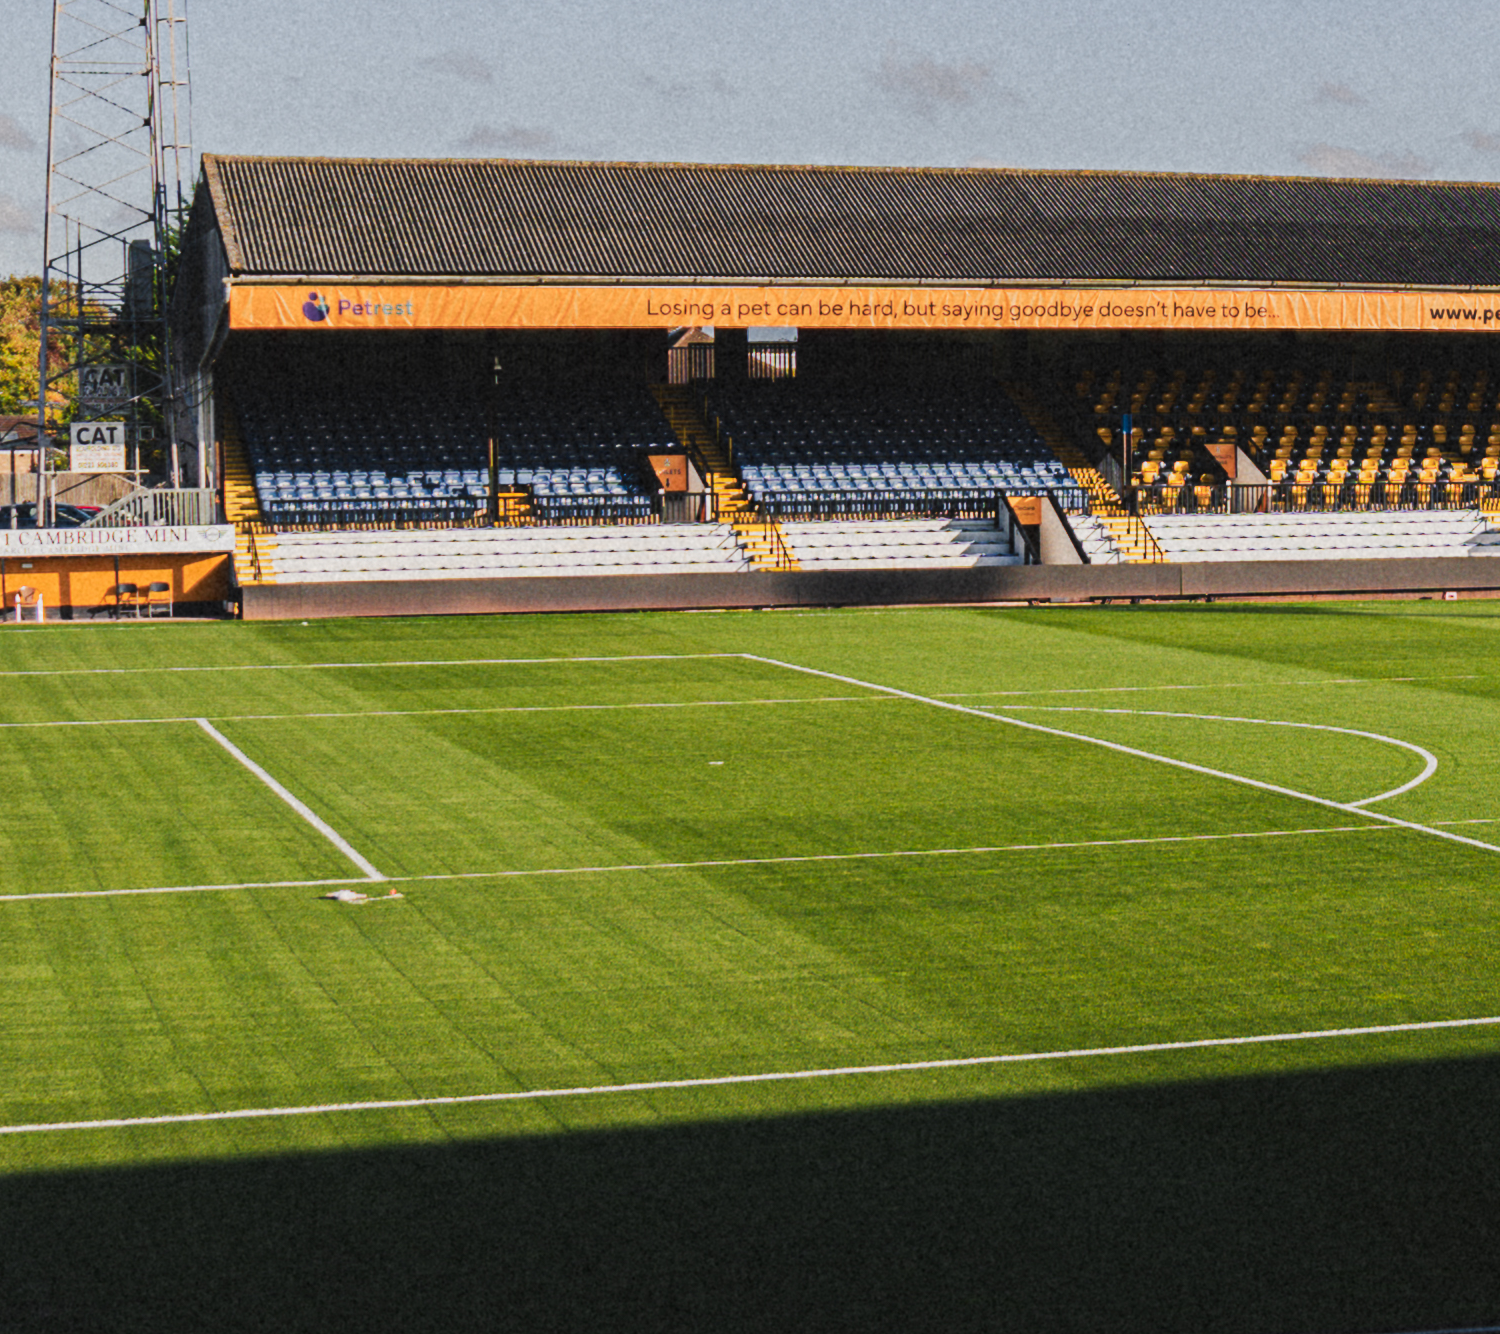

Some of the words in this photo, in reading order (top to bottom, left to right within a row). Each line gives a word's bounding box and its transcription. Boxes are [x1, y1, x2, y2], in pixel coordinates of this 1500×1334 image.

[338, 299, 414, 316] Petrest
[647, 299, 714, 319] Losing
[720, 303, 731, 316] a
[738, 300, 771, 319] pet
[777, 303, 812, 316] can
[818, 300, 843, 316] be
[850, 300, 898, 319] hard,
[904, 300, 936, 316] but
[942, 301, 1003, 320] saying
[1009, 301, 1094, 321] goodbye
[1099, 301, 1169, 318] doesn't
[1173, 302, 1216, 318] have
[1221, 303, 1240, 318] to
[1245, 302, 1280, 318] be...
[76, 426, 118, 445] CAT
[18, 529, 138, 546] CAMBRIDGE
[144, 528, 189, 543] MINI
